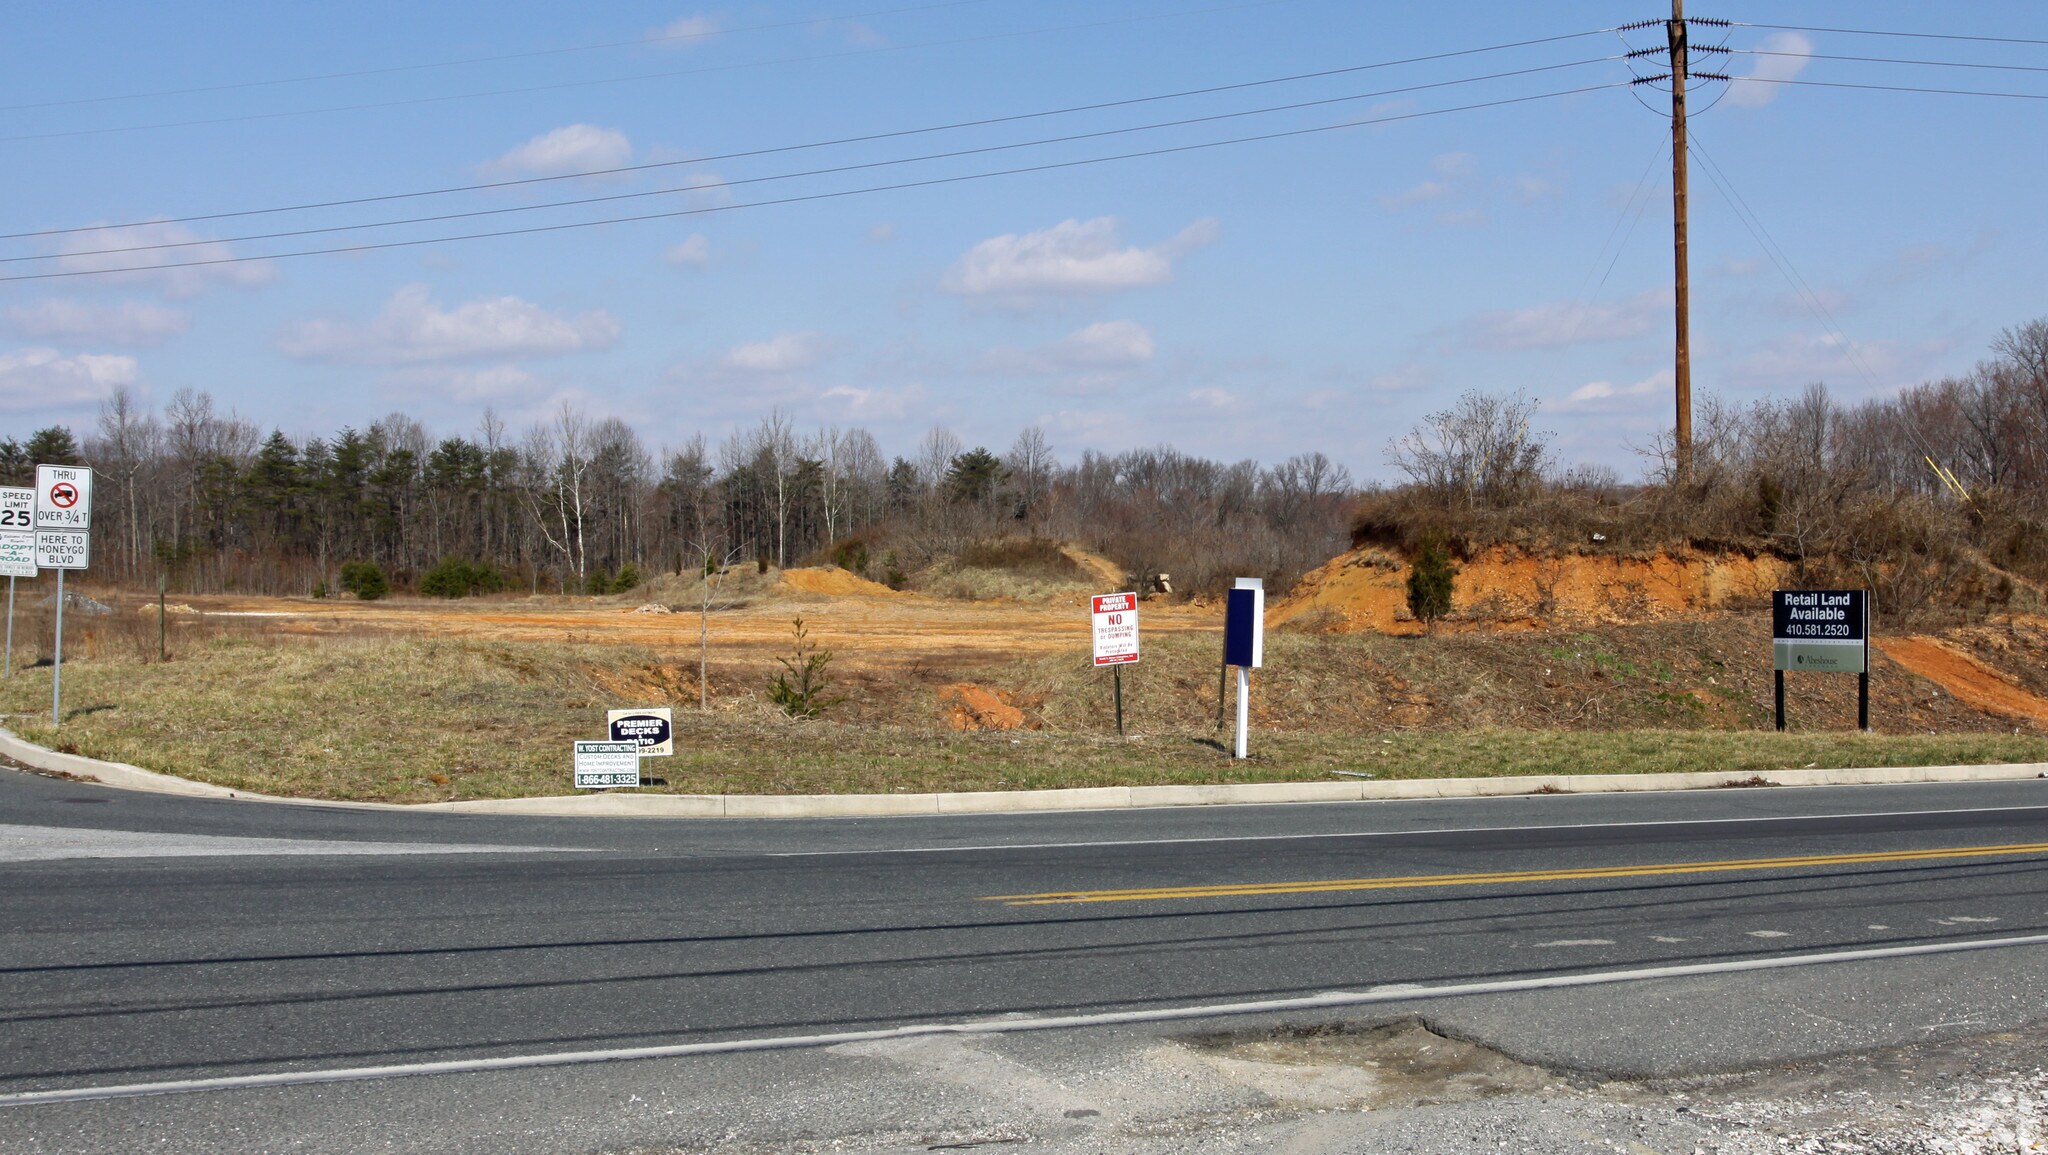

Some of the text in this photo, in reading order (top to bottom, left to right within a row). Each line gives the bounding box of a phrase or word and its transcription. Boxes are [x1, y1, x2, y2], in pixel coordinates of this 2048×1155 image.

[53, 470, 76, 480] THRU
[2, 492, 32, 500] SPEED
[0, 510, 31, 526] 25
[38, 509, 87, 524] OVER 3/4 T
[41, 536, 67, 544] HERE
[72, 536, 83, 544] TO
[38, 545, 84, 554] HONEYGO
[49, 555, 74, 564] BLVD
[1102, 596, 1126, 604] PRIVATE
[1785, 593, 1850, 606] Retail Land
[1099, 602, 1129, 611] PROPERTY
[1790, 607, 1845, 620] Available
[1108, 614, 1122, 625] NO
[1098, 625, 1134, 634] TRESPASSING
[1786, 624, 1849, 636] 410.581.2520
[617, 719, 663, 728] PREMIER
[621, 727, 660, 735] DECKS
[598, 744, 636, 752] CONTRACTING
[578, 774, 636, 785] 1-866-481-3325
